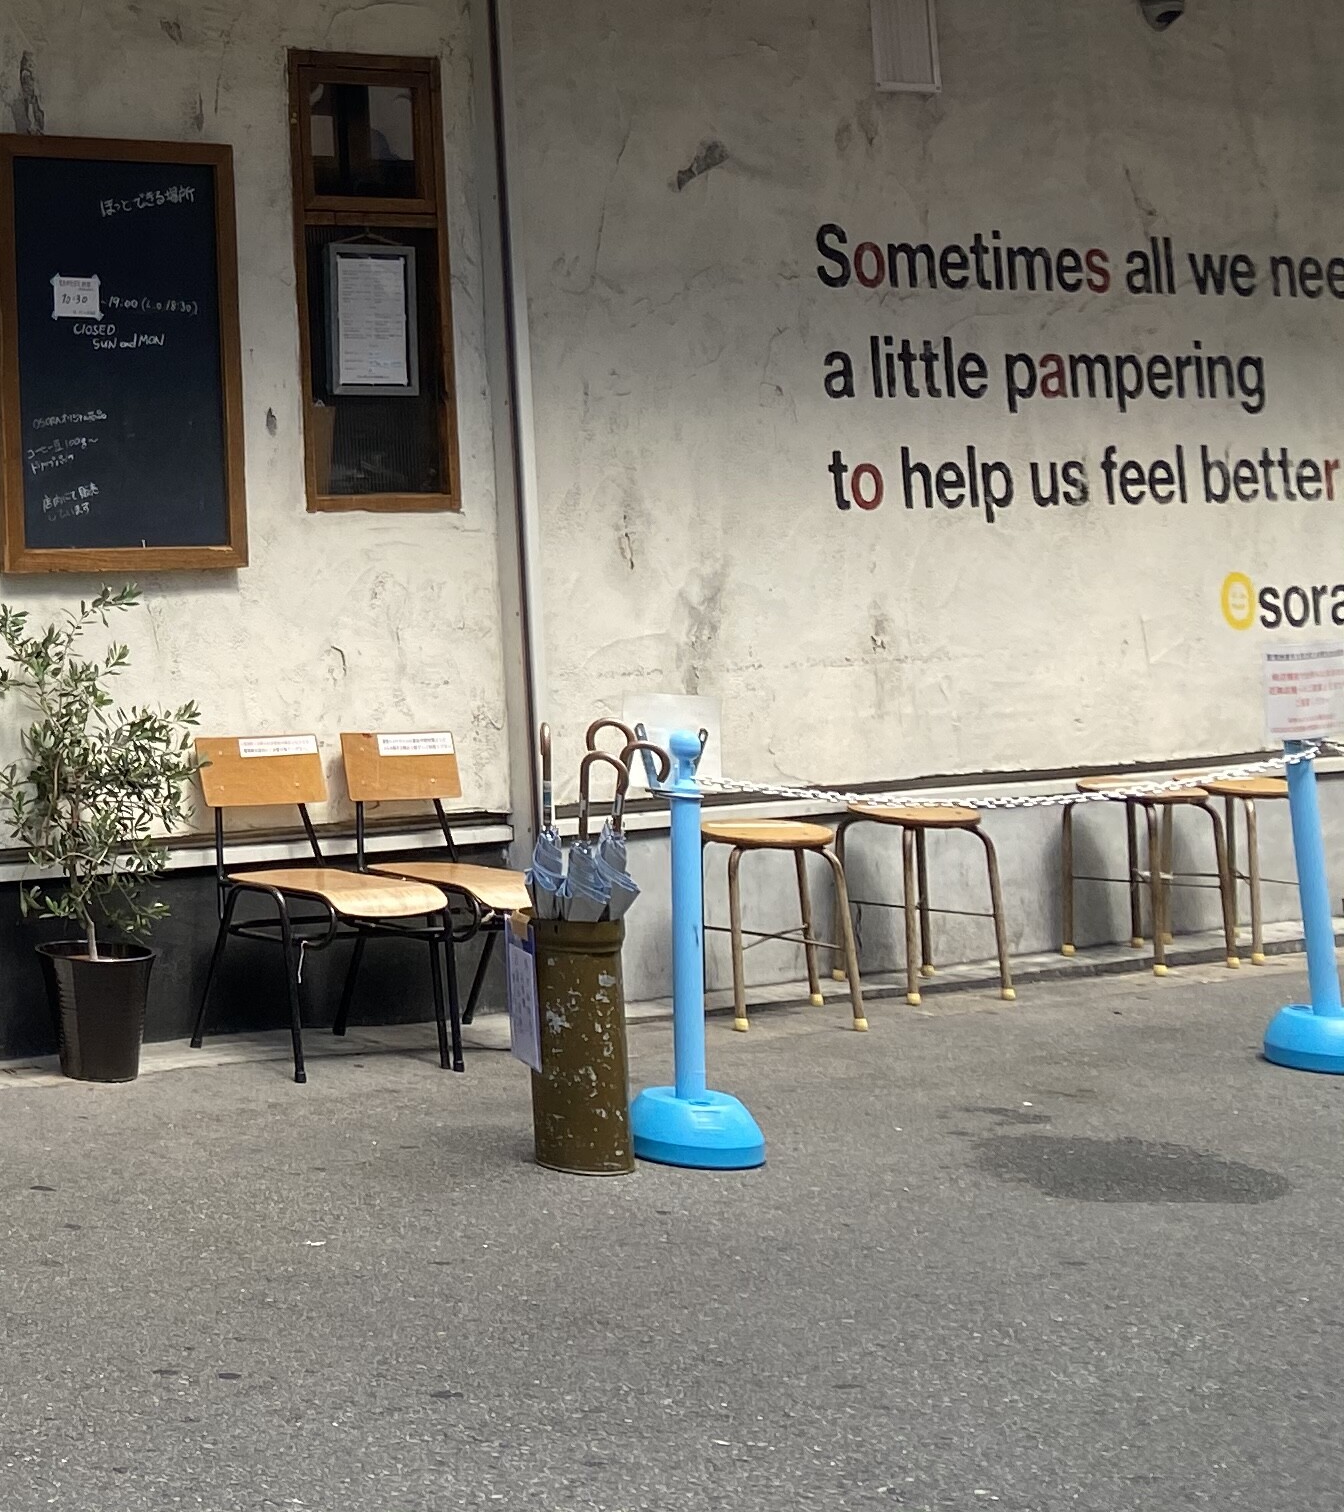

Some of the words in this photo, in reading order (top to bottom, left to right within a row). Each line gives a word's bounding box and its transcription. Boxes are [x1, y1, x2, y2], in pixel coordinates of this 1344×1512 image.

[815, 223, 1110, 295] Sometimes
[1125, 236, 1176, 294] all
[1188, 253, 1256, 297] we
[92, 338, 117, 350] SUN
[138, 333, 165, 348] MON
[823, 351, 855, 398] a
[870, 335, 988, 398] little
[1005, 340, 1265, 413] pampering
[829, 449, 884, 511] to
[901, 445, 1013, 523] help
[1030, 460, 1089, 506] us
[1100, 444, 1187, 505] feel
[1200, 444, 1341, 504] better
